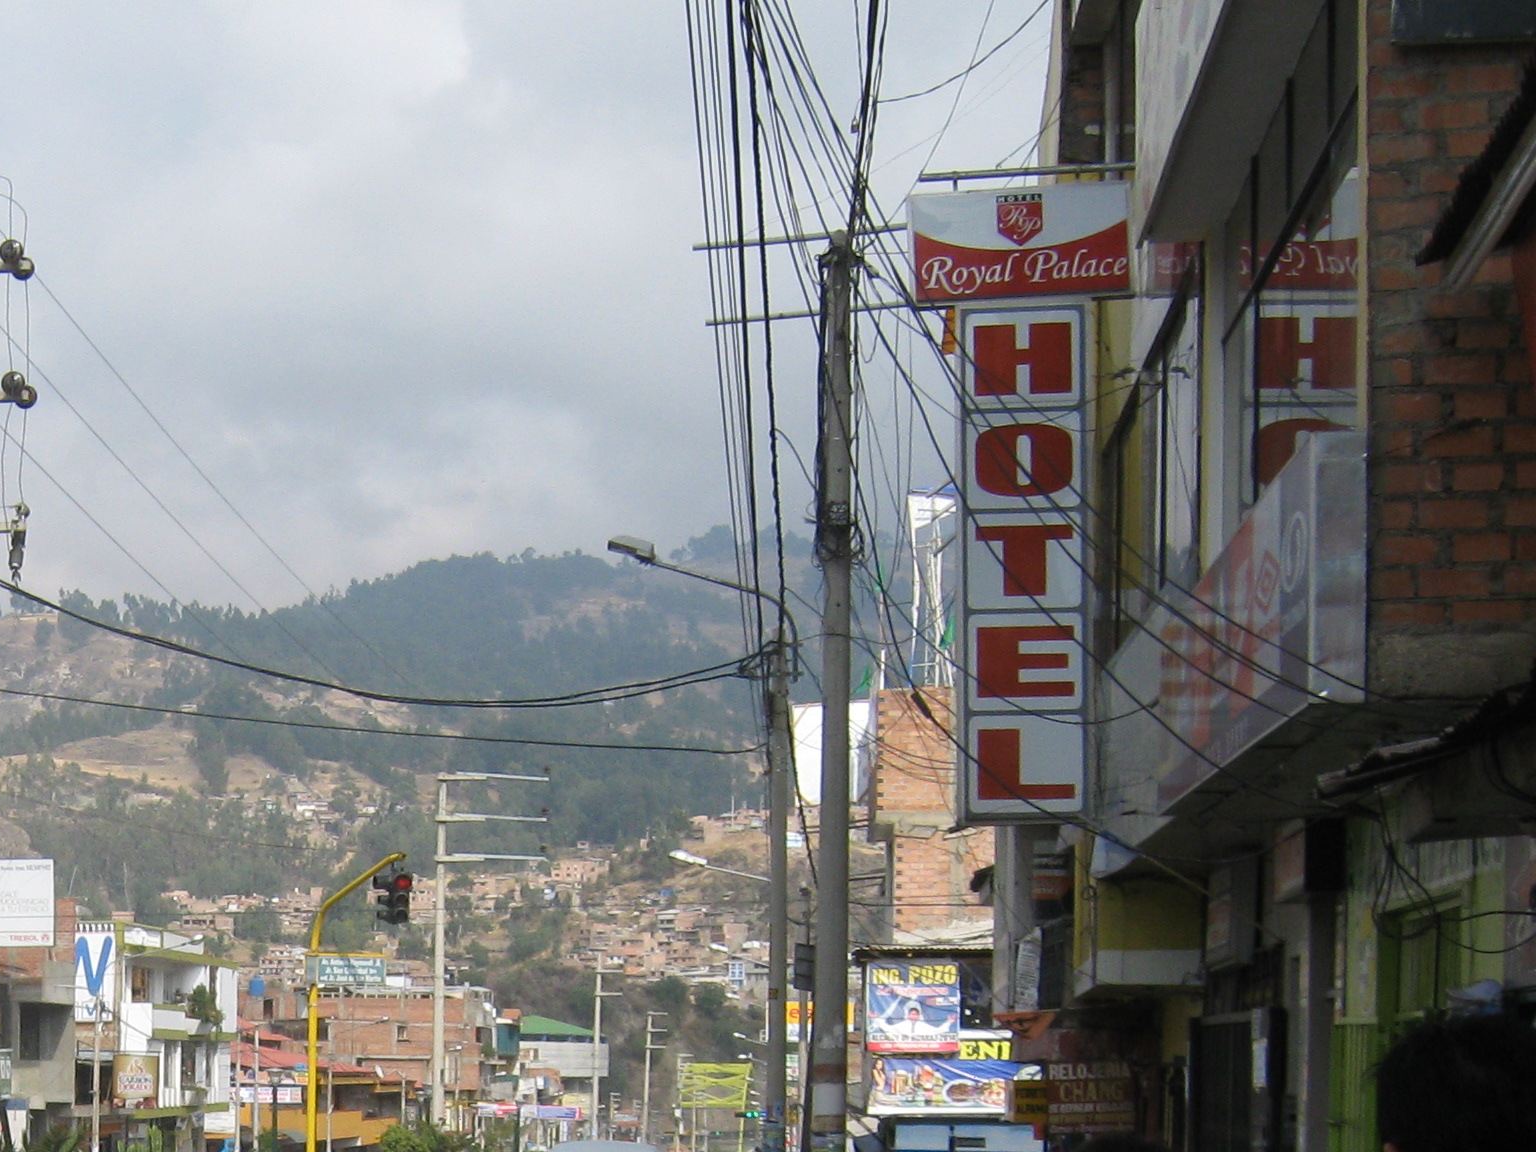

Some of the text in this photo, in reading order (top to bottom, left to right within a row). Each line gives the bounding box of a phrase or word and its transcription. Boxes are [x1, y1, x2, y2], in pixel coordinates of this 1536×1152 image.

[998, 194, 1041, 203] HOTEL
[922, 248, 1128, 295] Royal Palace
[972, 319, 1077, 801] HOTEL
[872, 964, 958, 985] ING. POZO
